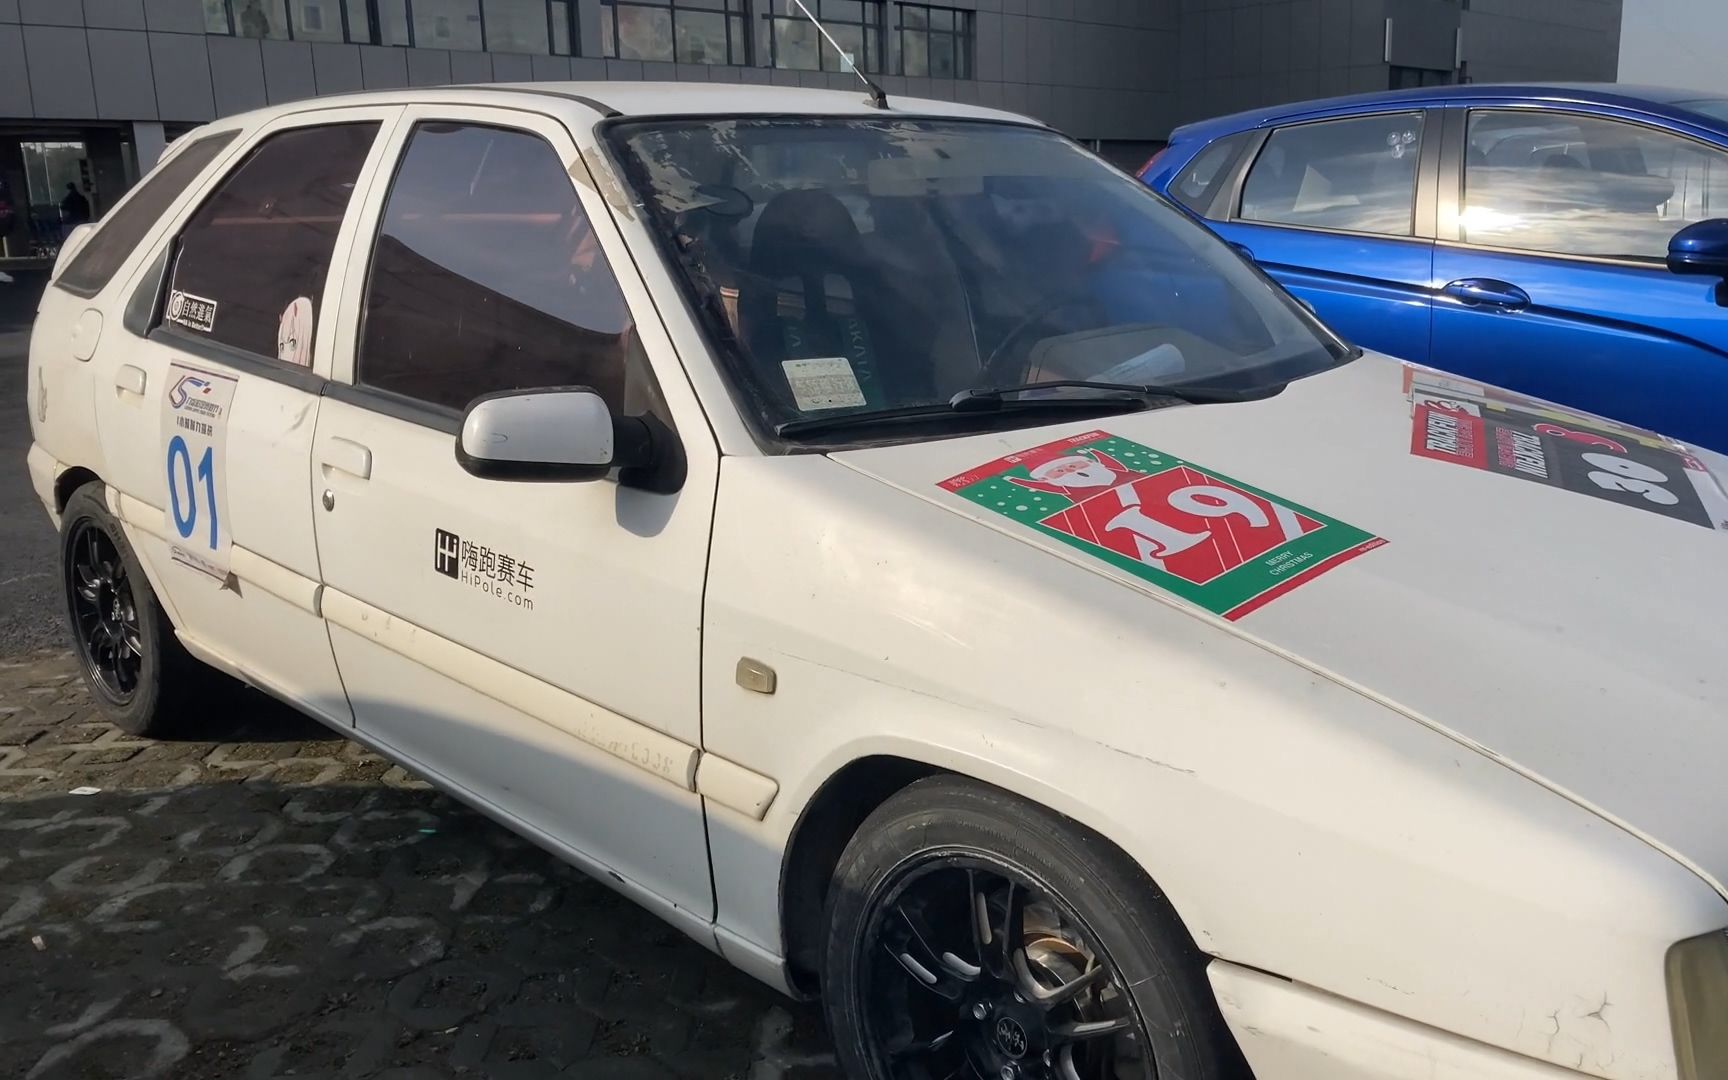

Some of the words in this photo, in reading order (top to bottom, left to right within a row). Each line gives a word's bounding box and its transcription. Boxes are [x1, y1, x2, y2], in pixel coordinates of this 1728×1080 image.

[167, 435, 218, 551] 01
[1581, 452, 1680, 506] 30
[1104, 484, 1270, 558] 19
[461, 540, 535, 593] 嗨跑赛车
[1265, 550, 1292, 567] MERRY
[1269, 551, 1314, 577] CHRISTMAS
[461, 570, 534, 611] HiPole.com
